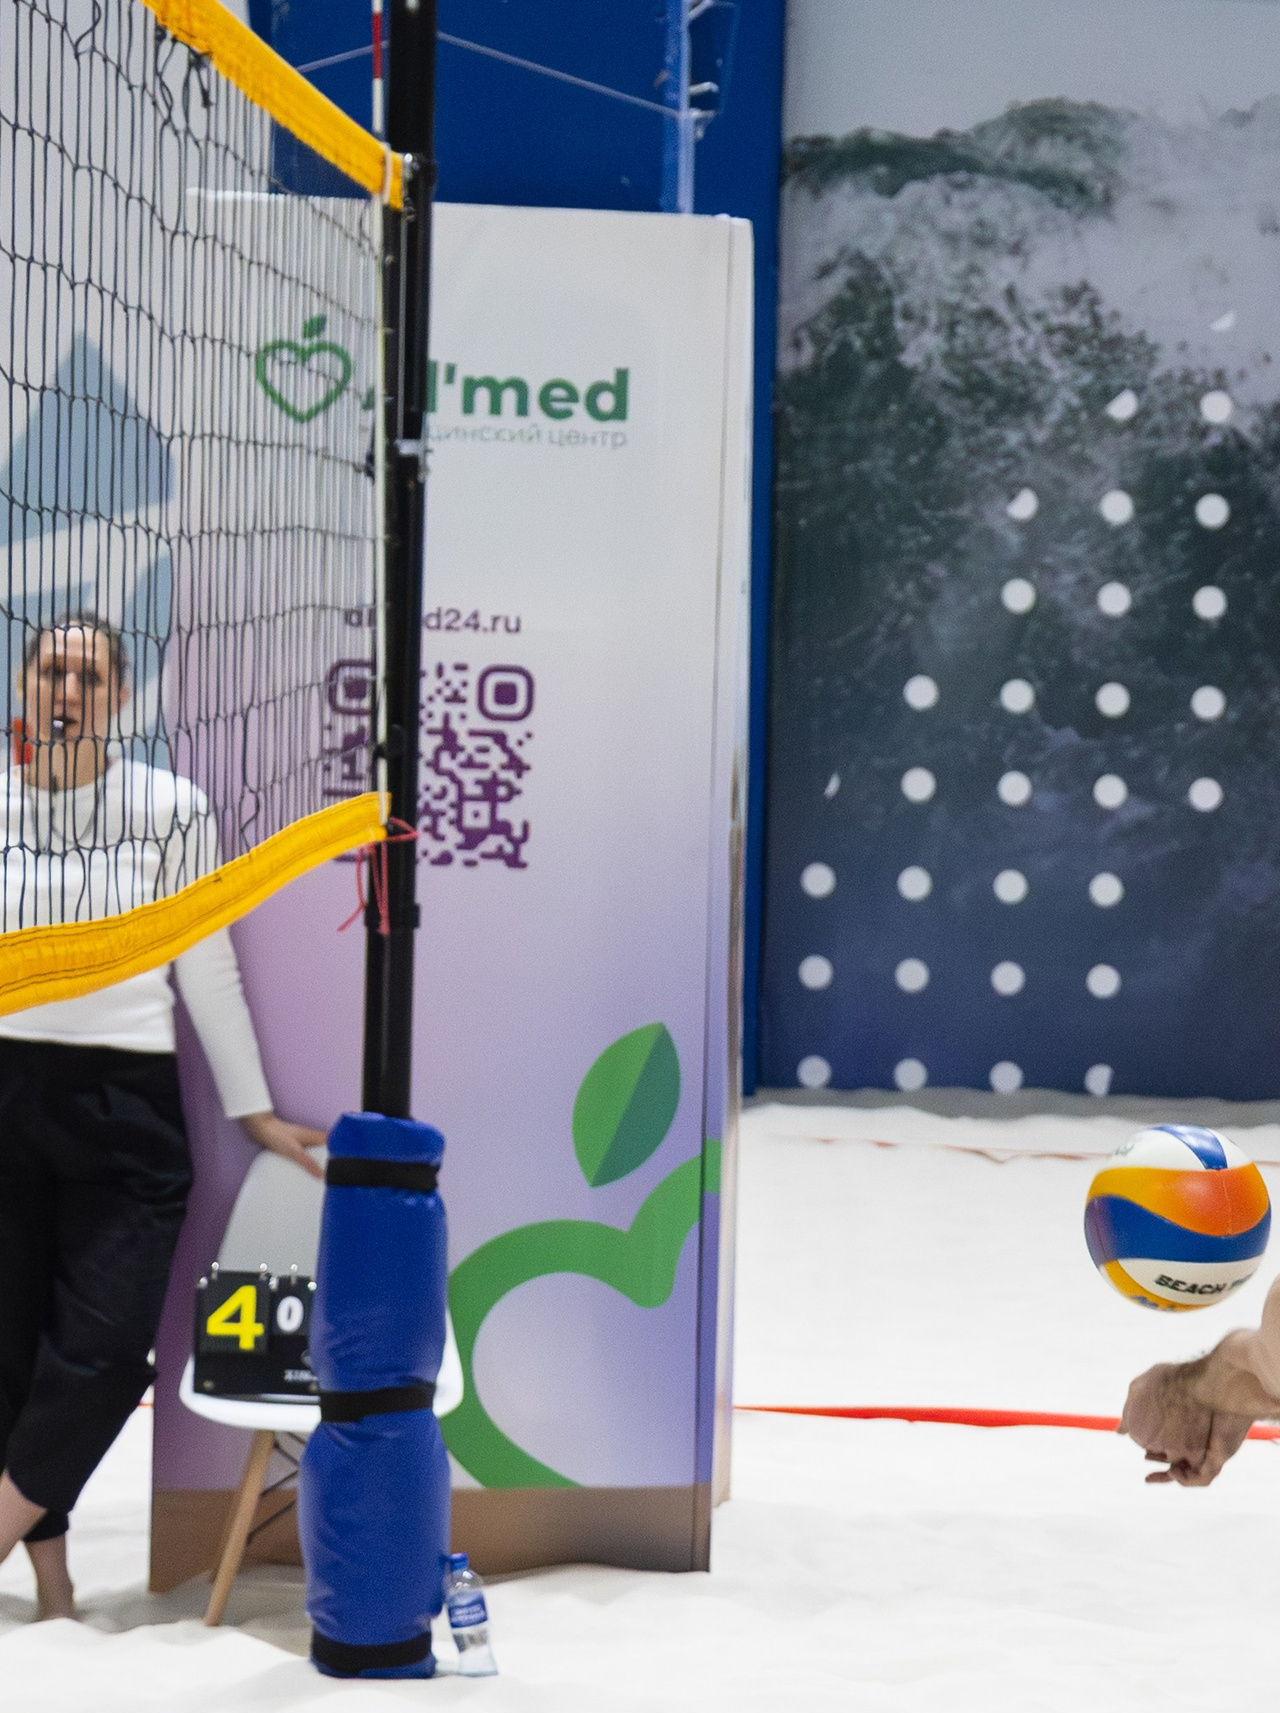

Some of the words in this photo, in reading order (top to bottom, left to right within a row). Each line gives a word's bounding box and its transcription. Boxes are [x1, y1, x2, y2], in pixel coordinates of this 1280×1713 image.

[361, 360, 629, 421] l'med
[548, 428, 628, 449] центр
[344, 606, 521, 633] ald24.ru
[1155, 1274, 1227, 1295] BEACH
[207, 1285, 264, 1350] 4
[277, 1296, 304, 1333] 0
